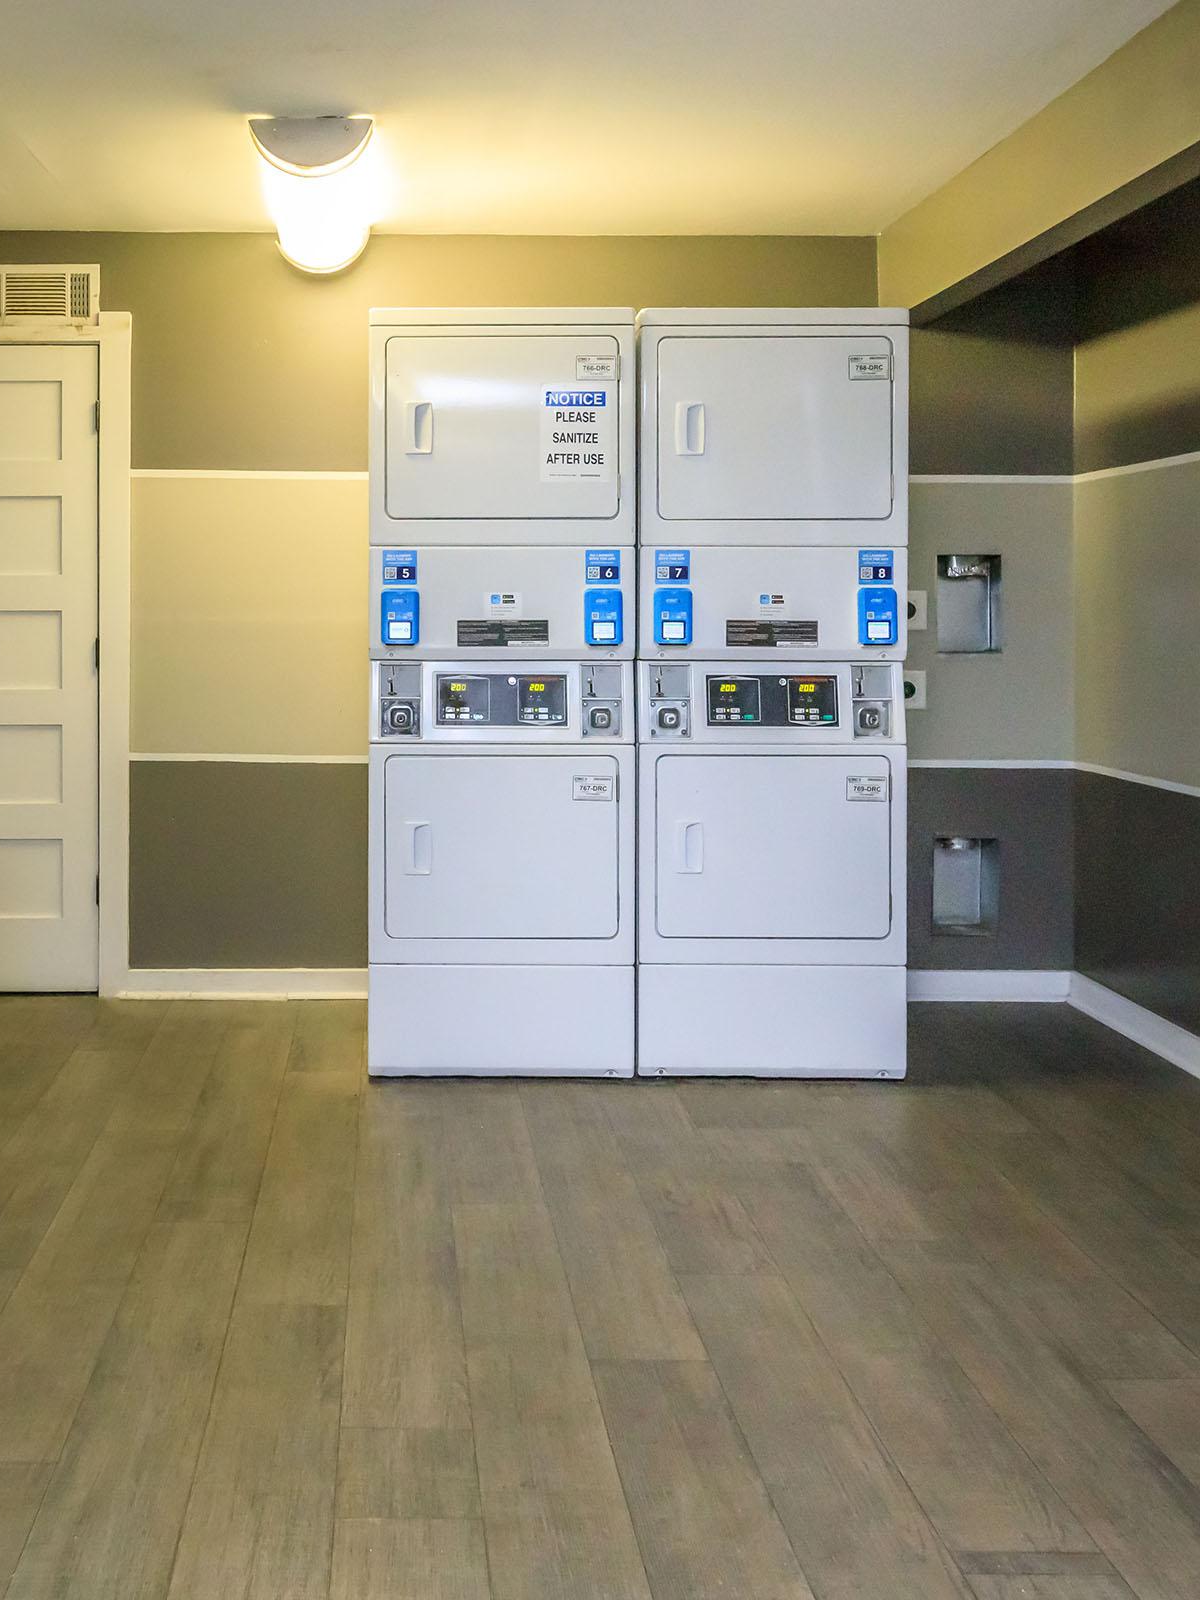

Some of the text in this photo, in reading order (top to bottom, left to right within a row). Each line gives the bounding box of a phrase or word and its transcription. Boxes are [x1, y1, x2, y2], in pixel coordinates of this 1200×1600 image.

[548, 392, 603, 406] NOTICE
[555, 411, 597, 423] PLEASE
[552, 432, 599, 444] SANITIZE
[546, 453, 604, 465] AFTER USE
[402, 568, 410, 579] 5
[605, 567, 613, 578] 6
[674, 567, 683, 578] 7
[878, 567, 886, 579] 8
[528, 683, 545, 692] 200
[719, 684, 737, 692] 200
